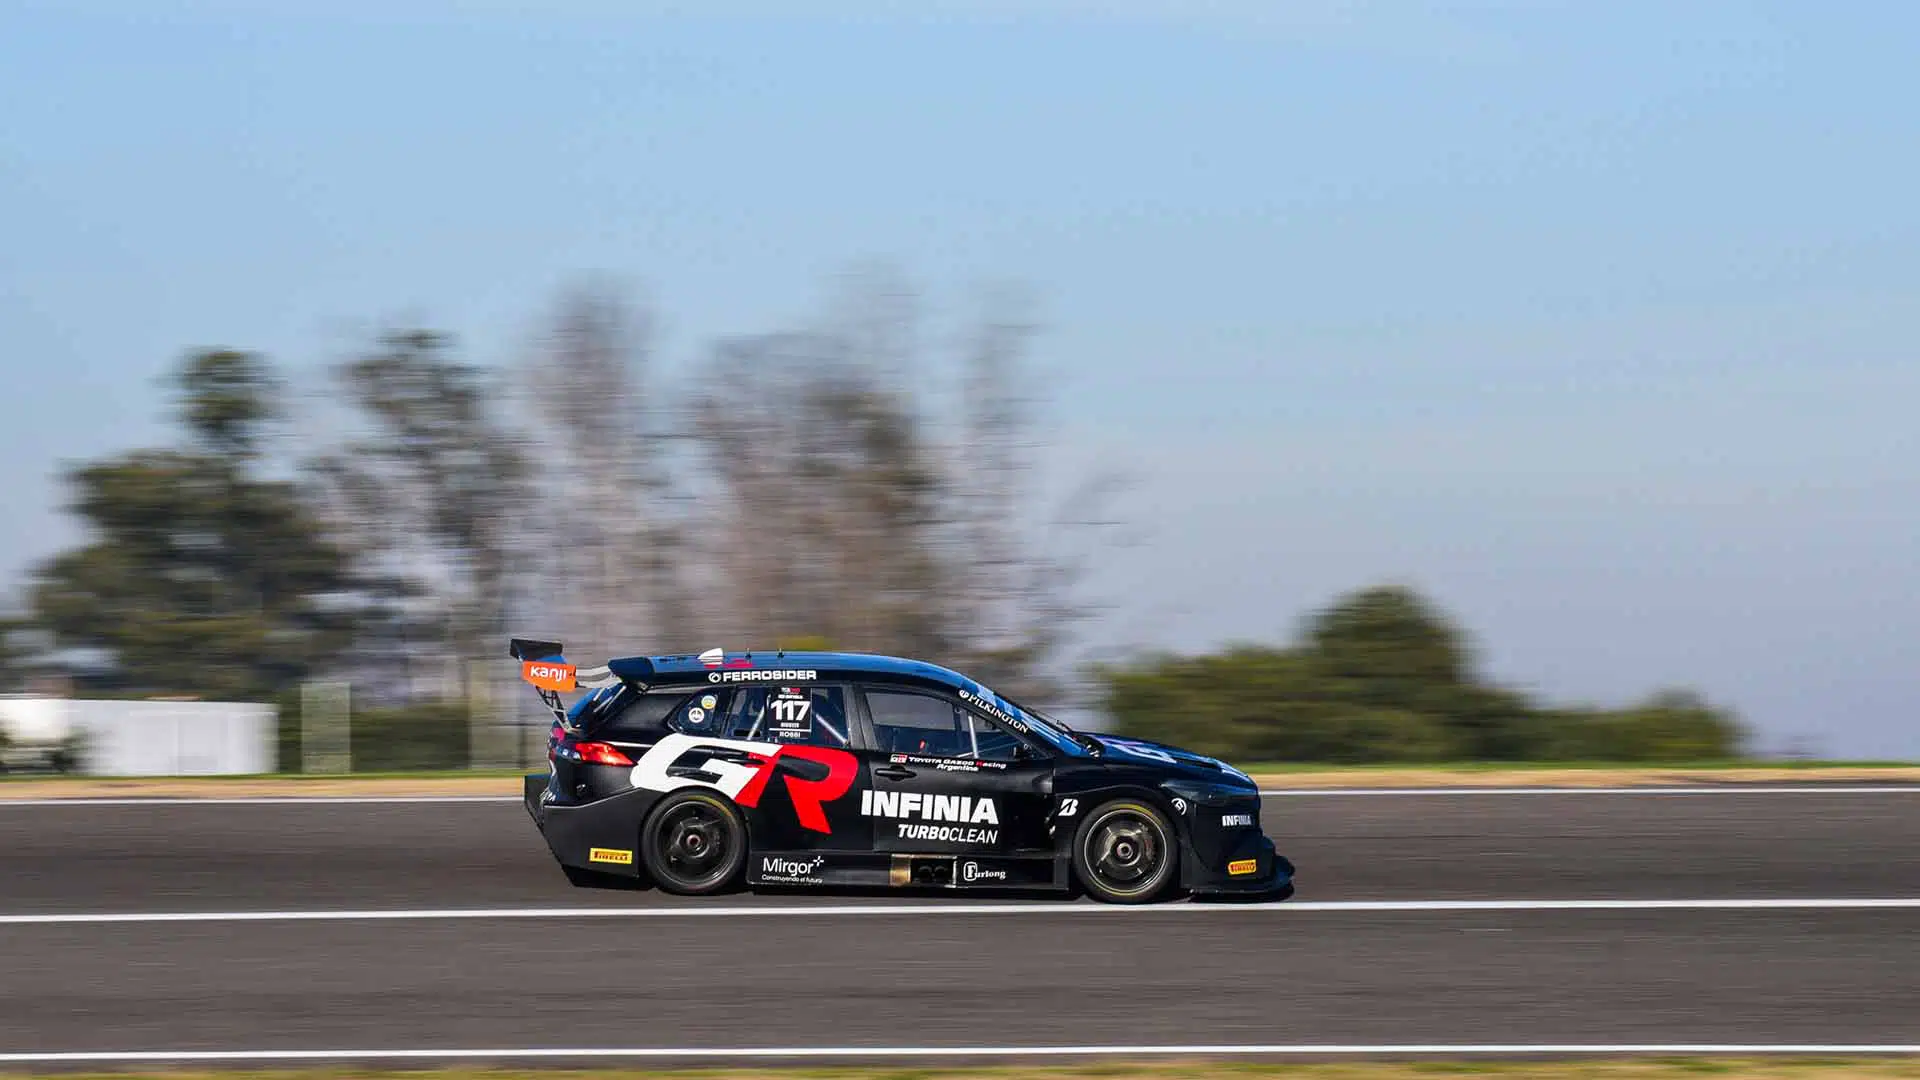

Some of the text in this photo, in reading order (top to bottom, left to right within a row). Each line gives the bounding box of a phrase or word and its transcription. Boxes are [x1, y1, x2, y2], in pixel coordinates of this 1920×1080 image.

[530, 665, 567, 681] kanji
[723, 670, 817, 682] FERROSIDER
[770, 700, 811, 721] 117
[967, 694, 1029, 733] PILKINGTON
[908, 756, 941, 764] TOYOTA
[975, 760, 1007, 769] Racing
[629, 733, 859, 835] GR
[861, 789, 999, 825] INFINIA
[898, 824, 998, 844] TURBOCLEAN
[763, 857, 814, 876] Mirgor
[963, 861, 1006, 881] Furlong
